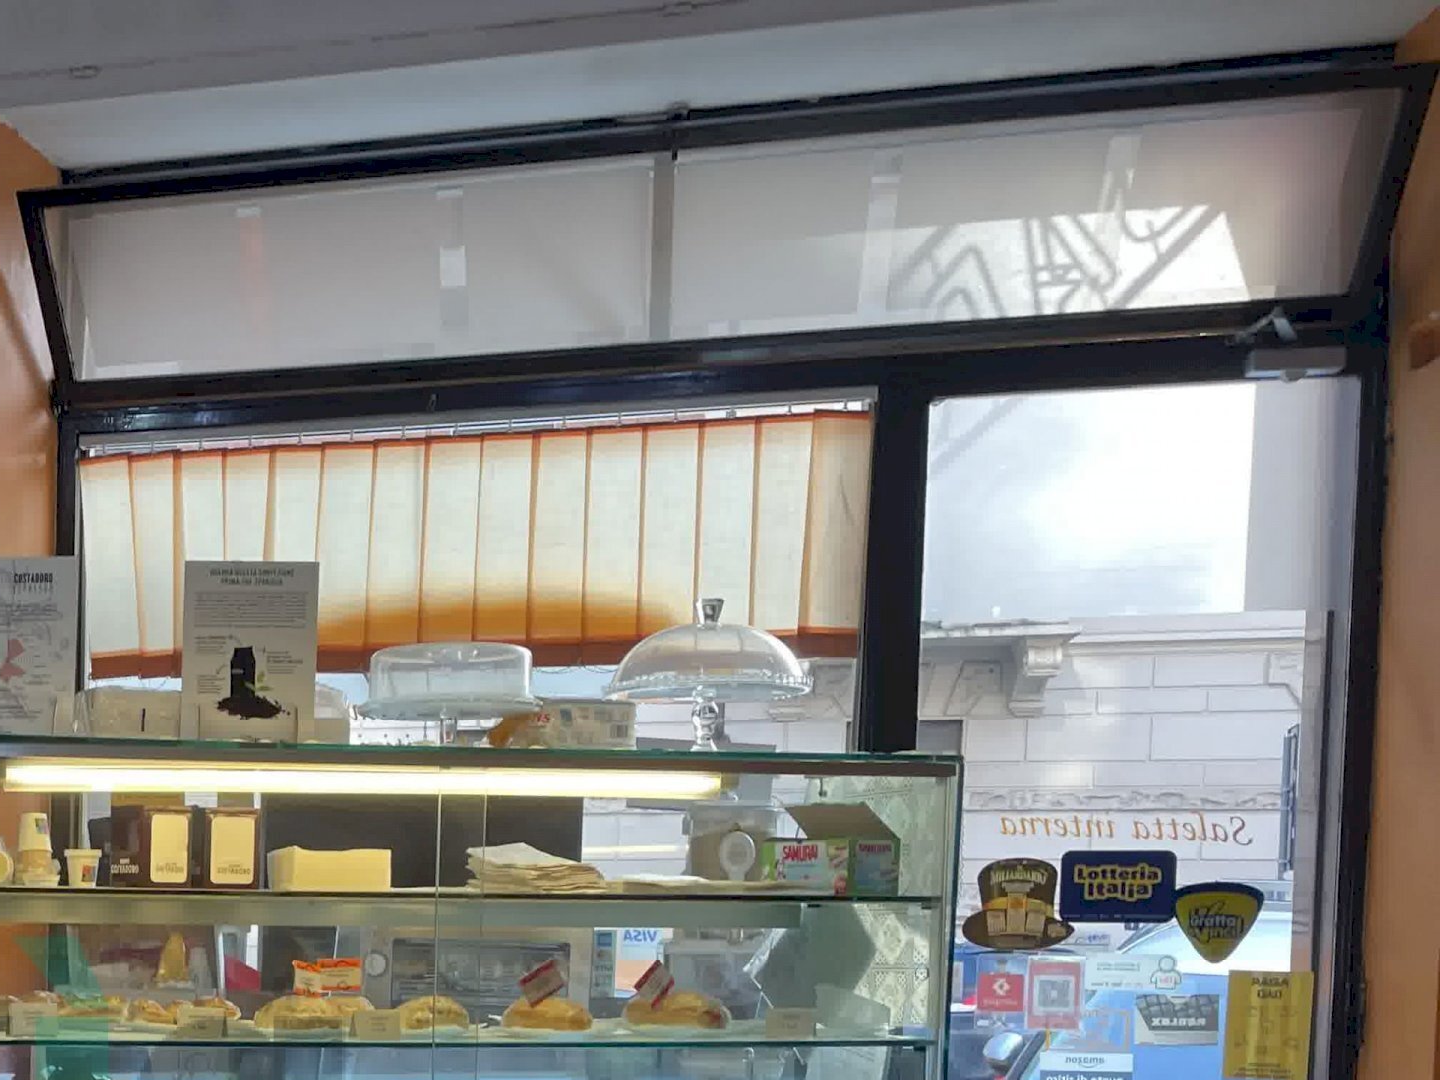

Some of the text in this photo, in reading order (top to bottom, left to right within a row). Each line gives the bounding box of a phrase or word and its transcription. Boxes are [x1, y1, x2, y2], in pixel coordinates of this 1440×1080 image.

[13, 573, 54, 584] COSTADORO
[782, 844, 818, 862] SAMURAI
[1075, 864, 1161, 883] Lotteria
[1087, 882, 1151, 900] Italia
[1191, 914, 1237, 927] Gratta
